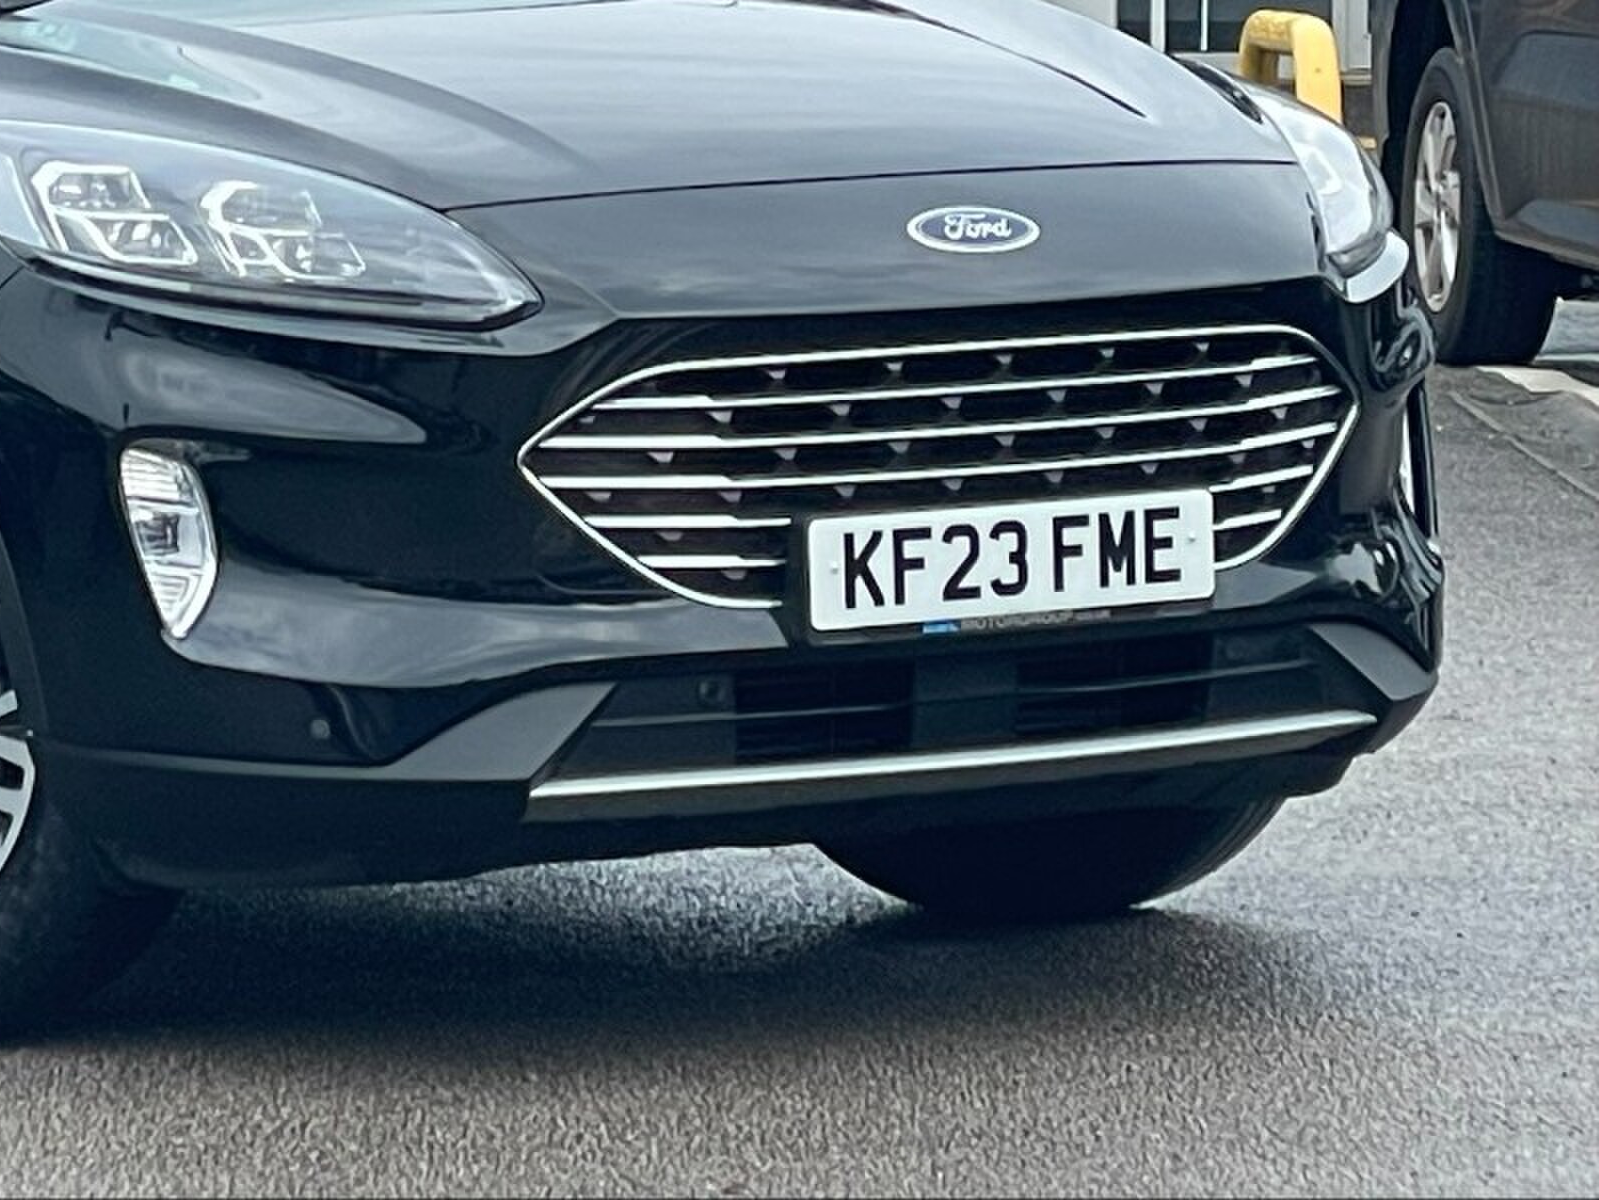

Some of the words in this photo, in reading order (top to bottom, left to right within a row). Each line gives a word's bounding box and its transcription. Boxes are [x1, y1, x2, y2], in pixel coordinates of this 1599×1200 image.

[943, 212, 1012, 240] Ford
[842, 519, 1029, 609] KF23
[1051, 507, 1182, 593] FME
